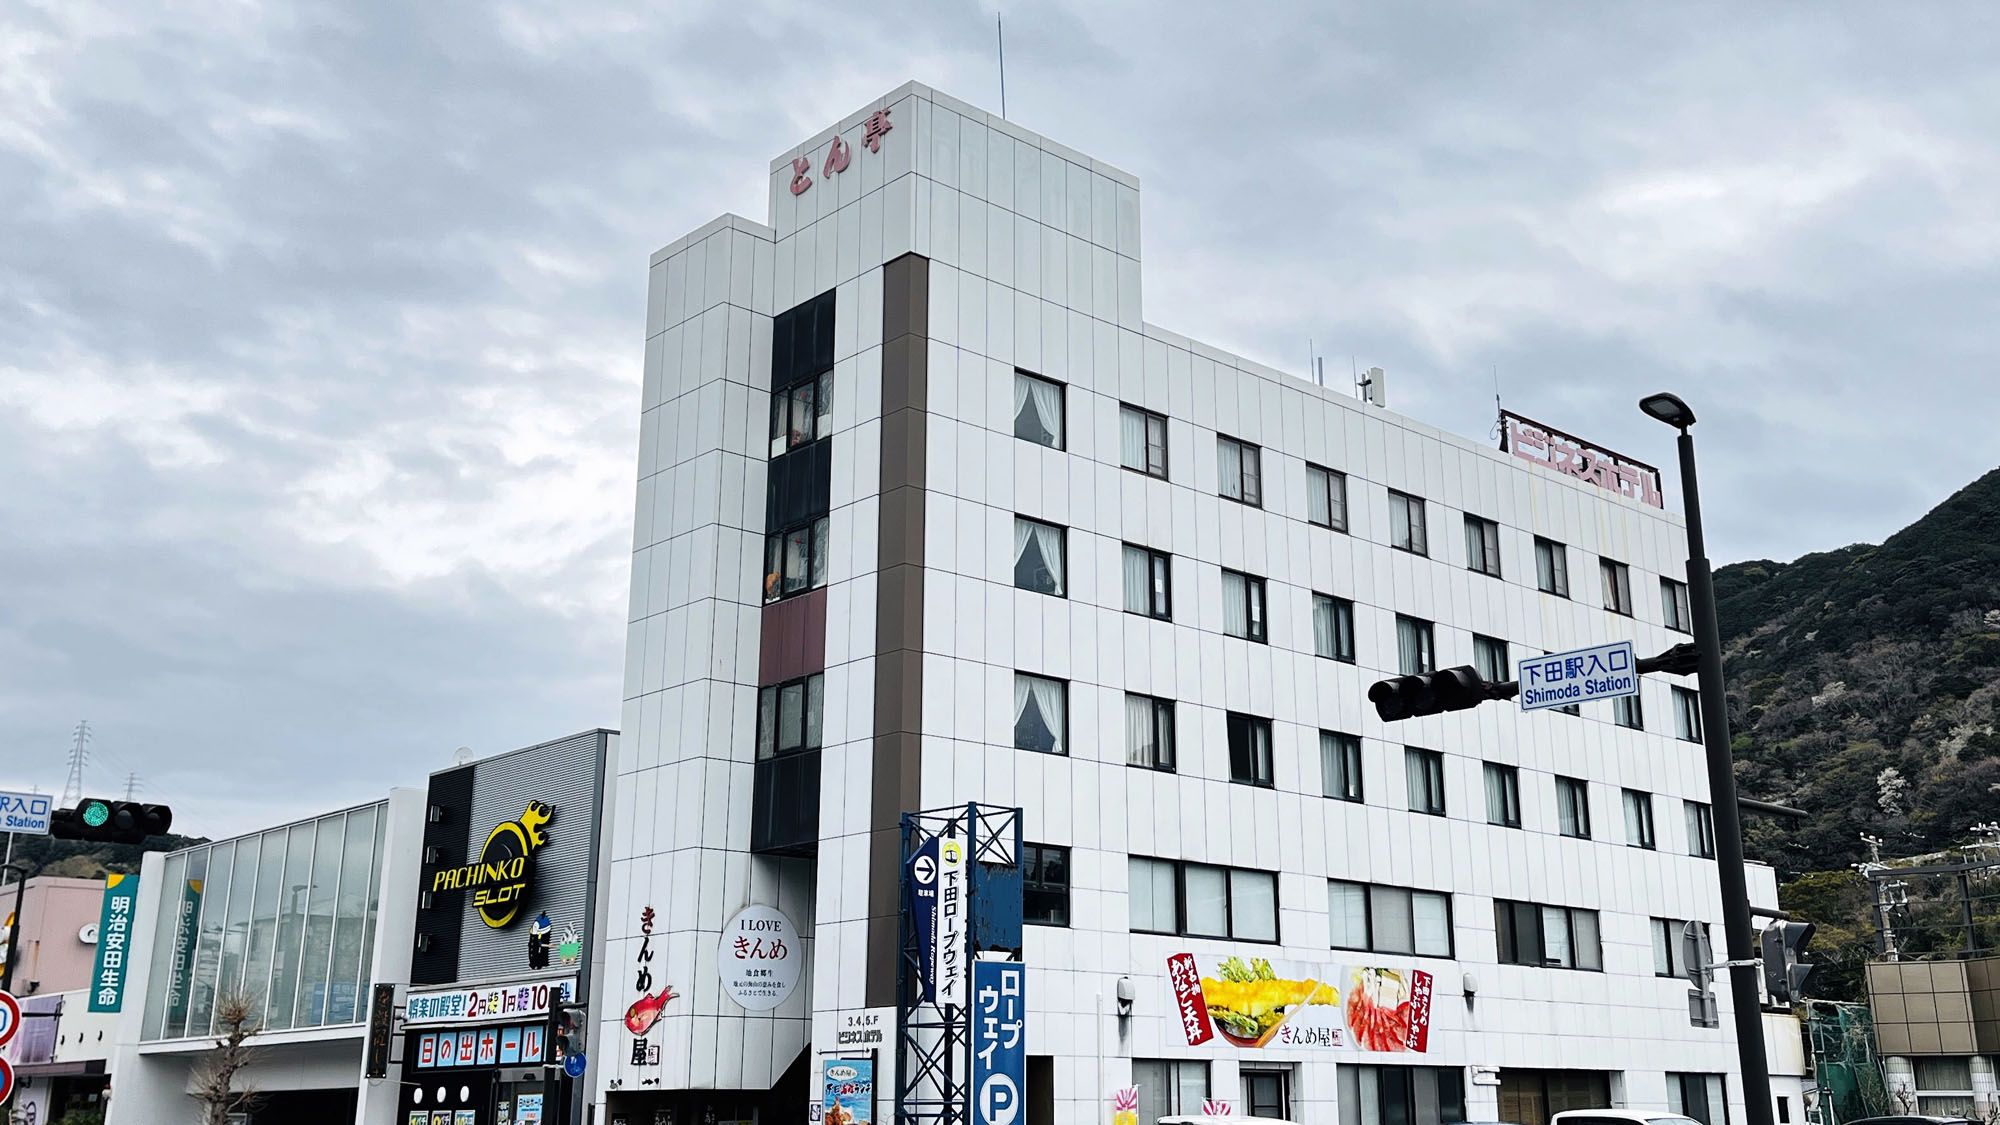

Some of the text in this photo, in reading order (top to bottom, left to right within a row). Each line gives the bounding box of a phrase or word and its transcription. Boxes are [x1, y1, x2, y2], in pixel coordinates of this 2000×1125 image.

[790, 108, 893, 196] とん亭
[1510, 422, 1662, 509] ビジネスホテル
[1522, 649, 1629, 686] 下田駅入口
[1524, 676, 1631, 705] Shimoda Station
[6, 815, 45, 829] Station
[433, 857, 525, 892] PACHINKO
[473, 883, 526, 907] SLOT
[741, 919, 782, 932] I LOVE
[929, 905, 937, 946] Shimoda
[941, 870, 959, 997] 下田ロープウェイ
[98, 896, 131, 1006] 明治安田生命
[733, 935, 788, 960] きんめ
[1183, 955, 1201, 996] 新名物
[1001, 970, 1023, 1049] ロープ
[1171, 959, 1203, 1044] あなご天丼
[1406, 972, 1423, 1048] しゃぶしゃぶ
[1419, 975, 1431, 1026] 下田きんめ
[421, 1031, 539, 1064] 日の出ホール
[977, 985, 999, 1070] ウェイ
[1281, 1024, 1331, 1047] きんめ屋
[989, 1084, 1013, 1122] P
